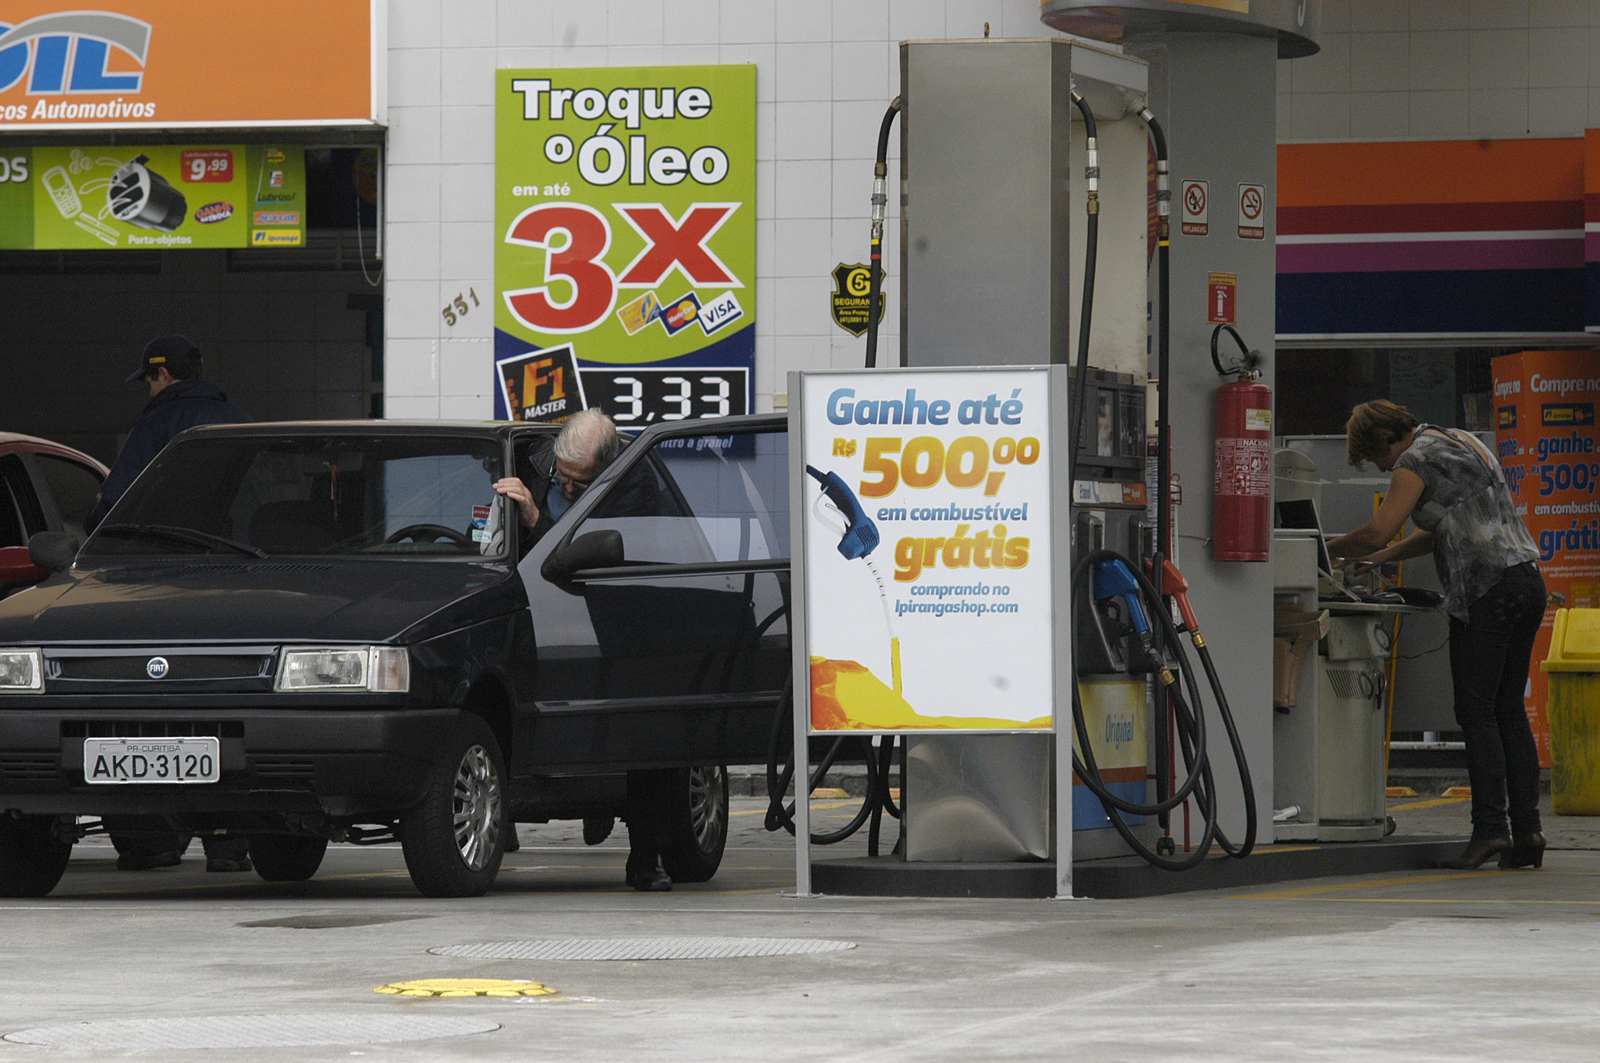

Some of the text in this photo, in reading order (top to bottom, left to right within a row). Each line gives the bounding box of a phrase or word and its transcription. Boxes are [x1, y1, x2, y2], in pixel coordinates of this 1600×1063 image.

[31, 97, 156, 119] Automotivos
[512, 79, 712, 129] Troque
[544, 123, 729, 186] o Óleo
[512, 182, 571, 196] em até
[128, 235, 192, 247] Porta-objetos
[442, 287, 480, 326] 551
[704, 299, 736, 323] VISA
[523, 358, 566, 408] F1
[1530, 373, 1585, 397] Compre
[525, 398, 567, 419] MASTER
[613, 377, 730, 421] 3,33
[826, 388, 1024, 425] Ganhe até
[686, 438, 694, 448] a
[696, 436, 733, 451] granel
[832, 438, 857, 457] R$
[1537, 430, 1594, 462] ganhe
[877, 502, 1028, 521] em combustível
[1534, 504, 1550, 515] em
[894, 523, 1030, 582] grátis
[1539, 519, 1600, 562] gráti
[910, 582, 1010, 599] comprando no
[895, 599, 1019, 617] Ipirangashop.com
[149, 664, 165, 673] FIAT
[1106, 713, 1134, 750] Original
